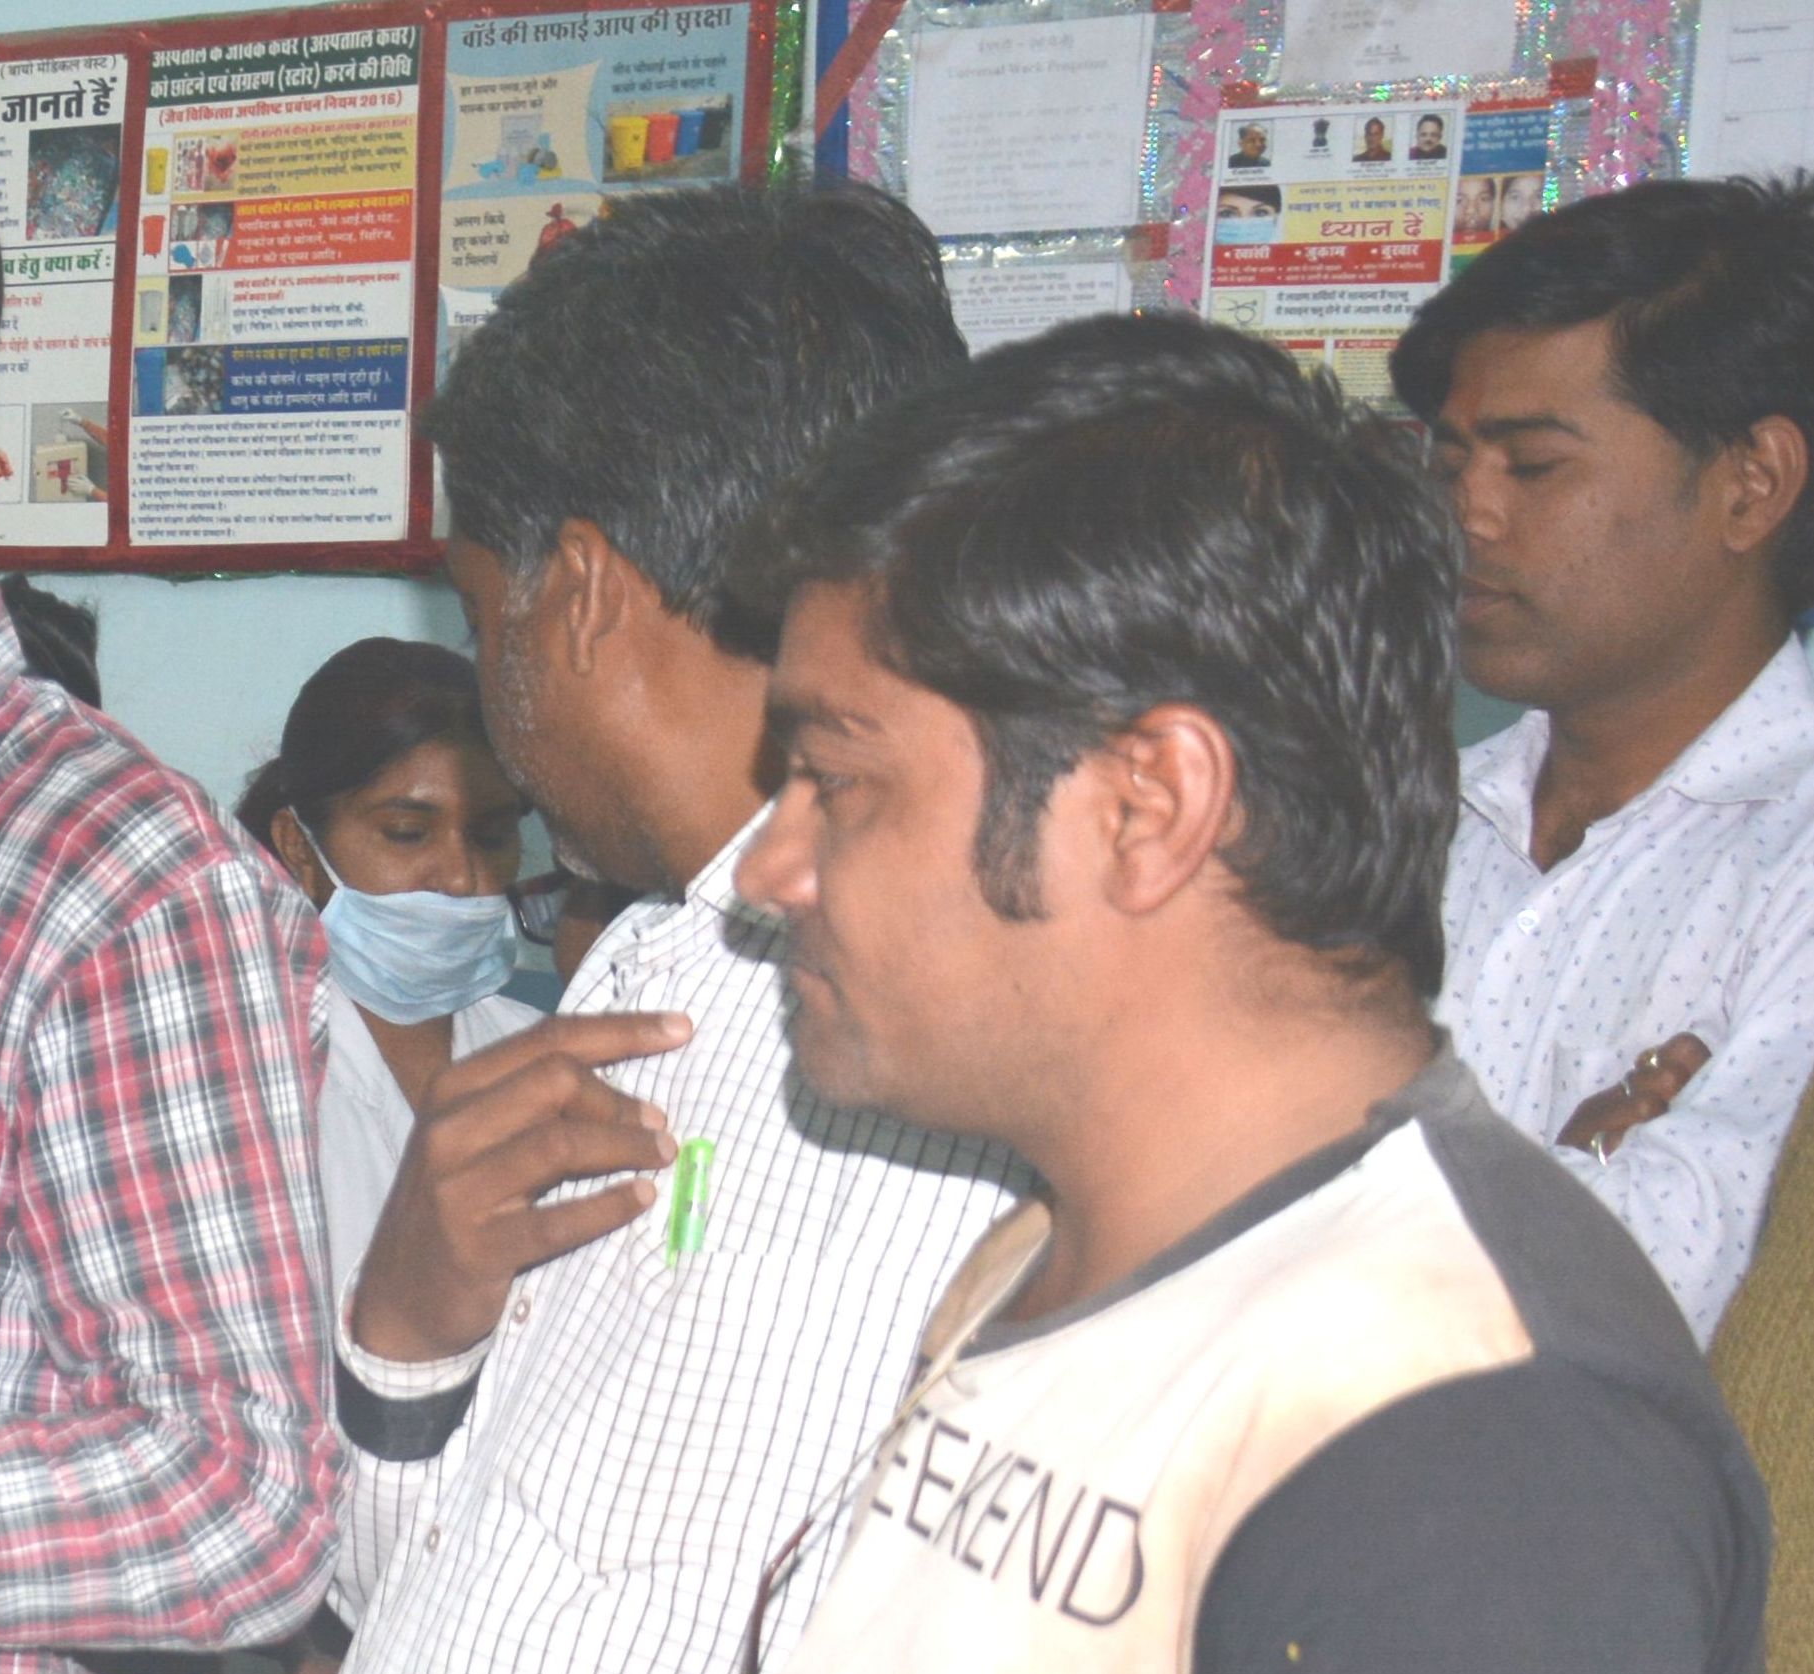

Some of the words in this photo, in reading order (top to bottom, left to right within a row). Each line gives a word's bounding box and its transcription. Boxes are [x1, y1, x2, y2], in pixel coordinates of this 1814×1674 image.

[462, 22, 496, 49] वॉर्ड
[501, 17, 530, 44] की
[533, 12, 590, 43] सफाई
[593, 14, 636, 38] आप
[640, 6, 670, 33] की
[675, 5, 734, 38] सुरक्षा
[150, 77, 169, 99] को
[207, 67, 228, 94] एवं
[230, 67, 275, 93] संग्रहण
[277, 61, 321, 93] (स्टोर)
[324, 57, 357, 84] करने
[359, 55, 378, 80] की
[380, 53, 412, 79] विधि
[1, 79, 87, 124] जानते
[88, 76, 118, 118] हैं
[494, 230, 511, 246] को
[1320, 217, 1393, 239] ध्यान
[1402, 211, 1425, 238] दें
[18, 253, 41, 280] हेतु
[44, 254, 73, 273] क्या
[76, 248, 103, 270] करें
